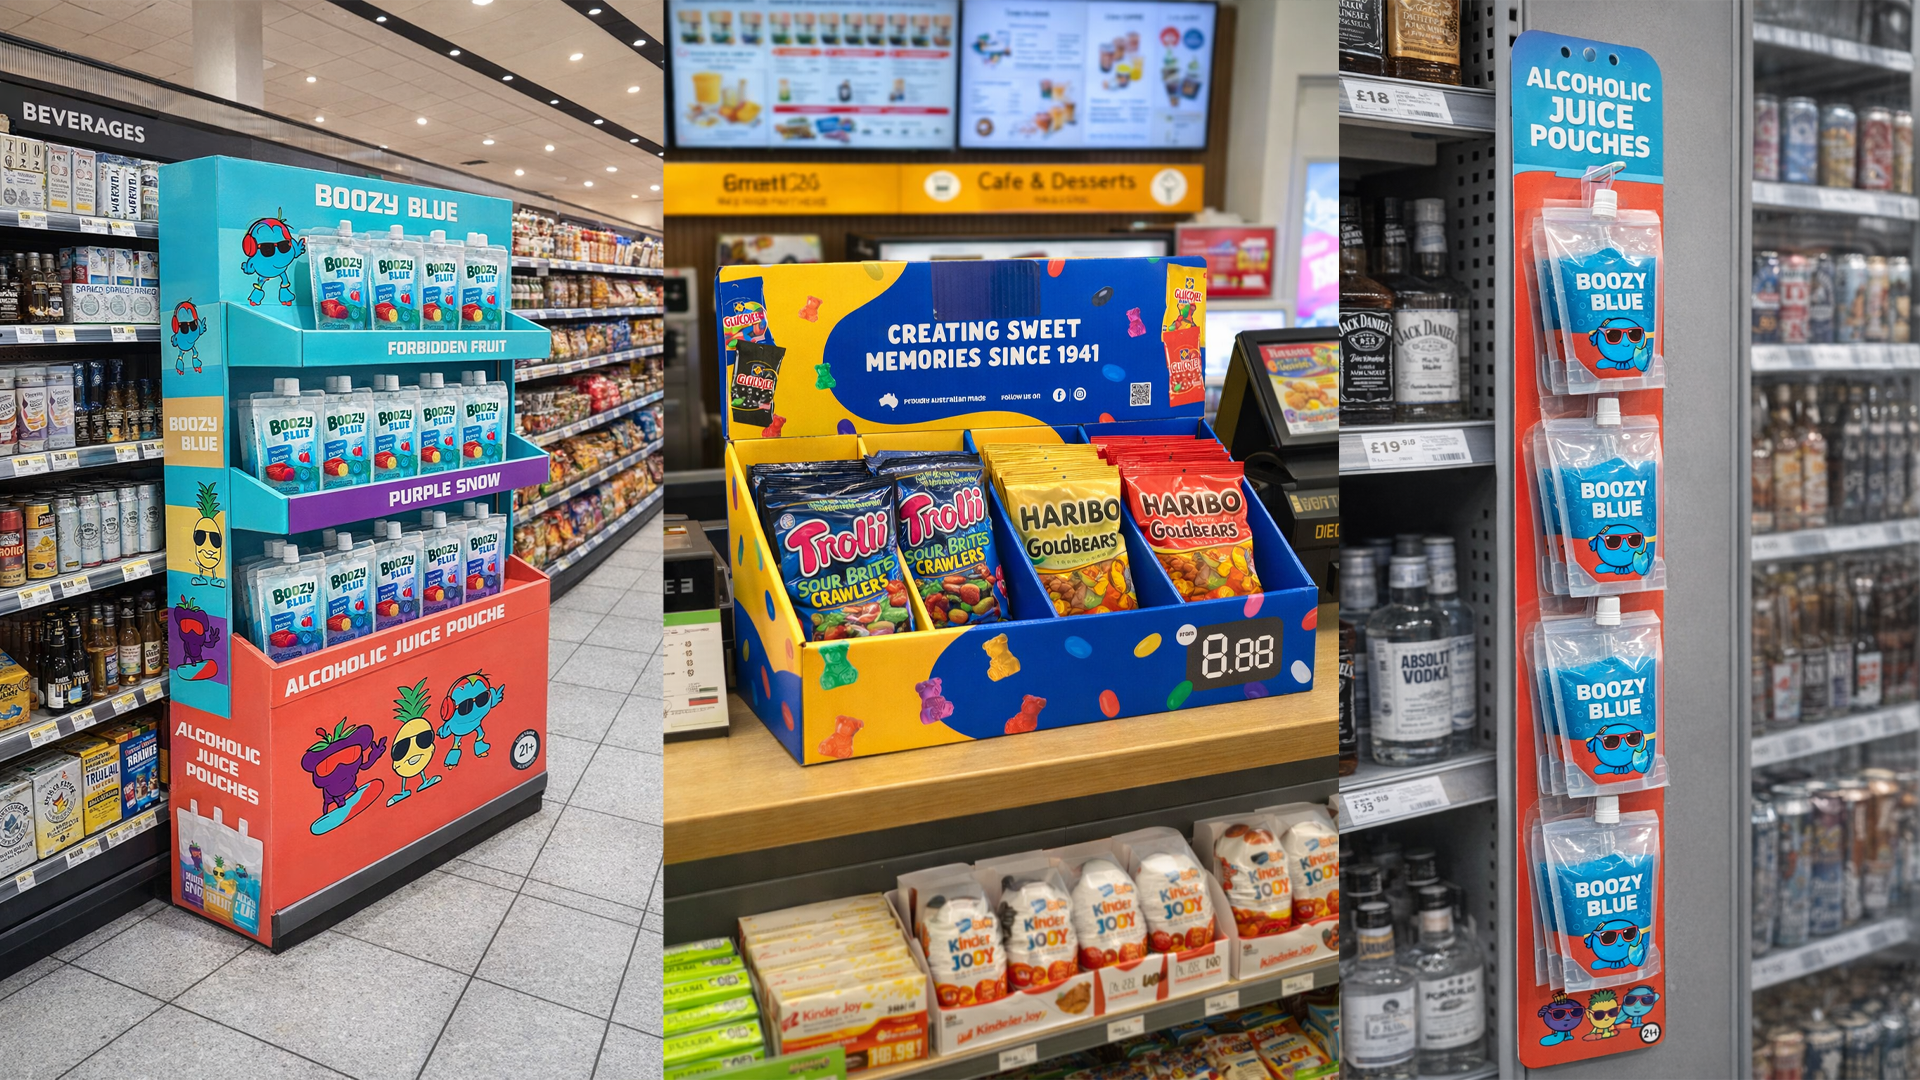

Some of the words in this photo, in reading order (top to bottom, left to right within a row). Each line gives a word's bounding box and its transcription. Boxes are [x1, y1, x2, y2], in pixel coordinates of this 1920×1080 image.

[1526, 66, 1651, 102] ALCOHOLIC
[1356, 89, 1390, 104] £18
[22, 101, 146, 143] BEVERAGES
[1549, 96, 1634, 131] JUICE
[1530, 123, 1650, 158] POUCHES
[977, 172, 1030, 191] Cafe
[1030, 172, 1045, 190] &
[1051, 172, 1136, 190] Desserts
[315, 183, 399, 215] BOOZY
[407, 198, 459, 222] BLUE
[336, 268, 360, 279] BLUE
[388, 270, 411, 280] BLUE
[435, 272, 454, 283] BLUE
[475, 273, 496, 284] BLUE
[1576, 272, 1647, 291] BOOZY
[1591, 293, 1644, 311] BLUE
[888, 321, 1000, 345] CREATING
[1006, 319, 1081, 340] SWEET
[1395, 323, 1422, 346] JACK
[388, 340, 467, 355] FORBIDDEN
[470, 339, 507, 353] FRUIT
[866, 348, 981, 372] MEMORIES
[988, 346, 1051, 366] SINCE
[1057, 344, 1099, 363] 1941
[169, 416, 218, 432] BOOZY
[388, 420, 410, 432] BLUE
[433, 415, 453, 427] BLUE
[475, 411, 496, 422] BLUE
[282, 428, 310, 442] BLUE
[339, 423, 362, 437] BLUE
[181, 435, 218, 452] BLUE
[1371, 440, 1400, 454] £19
[389, 481, 451, 507] PURPLE
[456, 471, 501, 494] SNOW
[1581, 480, 1647, 499] BOOZY
[1140, 490, 1241, 518] HARIBO
[1592, 500, 1643, 519] BLUE
[899, 487, 985, 547] Trolli
[1020, 497, 1120, 533] HARIBO
[479, 543, 496, 555] BLUE
[785, 511, 888, 577] Trolli
[904, 544, 943, 565] SOUR
[948, 532, 990, 554] BRITES
[437, 554, 456, 567] BLUE
[915, 547, 985, 575] CRAWLERS
[391, 566, 412, 580] BLUE
[342, 579, 364, 594] BLUE
[797, 574, 843, 598] SOUR
[811, 573, 889, 608] CRAWLERS
[286, 594, 312, 610] BLUE
[284, 645, 387, 697] ALCOHOLIC
[392, 625, 441, 657] JUICE
[446, 603, 505, 637] POUCHE
[1403, 665, 1449, 684] VODKA
[1576, 678, 1647, 701] BOOZY
[1588, 698, 1642, 720] BLUE
[175, 721, 261, 765] ALCOHOLIC
[519, 743, 534, 758] 21+
[196, 748, 239, 777] JUICE
[186, 762, 259, 805] POUCHES
[1300, 851, 1336, 870] Kinder
[1248, 866, 1284, 884] Kinder
[1575, 873, 1643, 898] BOOZY
[1092, 899, 1131, 917] Kinder
[1587, 894, 1638, 917] BLUE
[1024, 915, 1065, 932] Kinder
[948, 934, 990, 953] Kinder
[803, 1005, 840, 1022] Kinder
[842, 1002, 862, 1014] Joy
